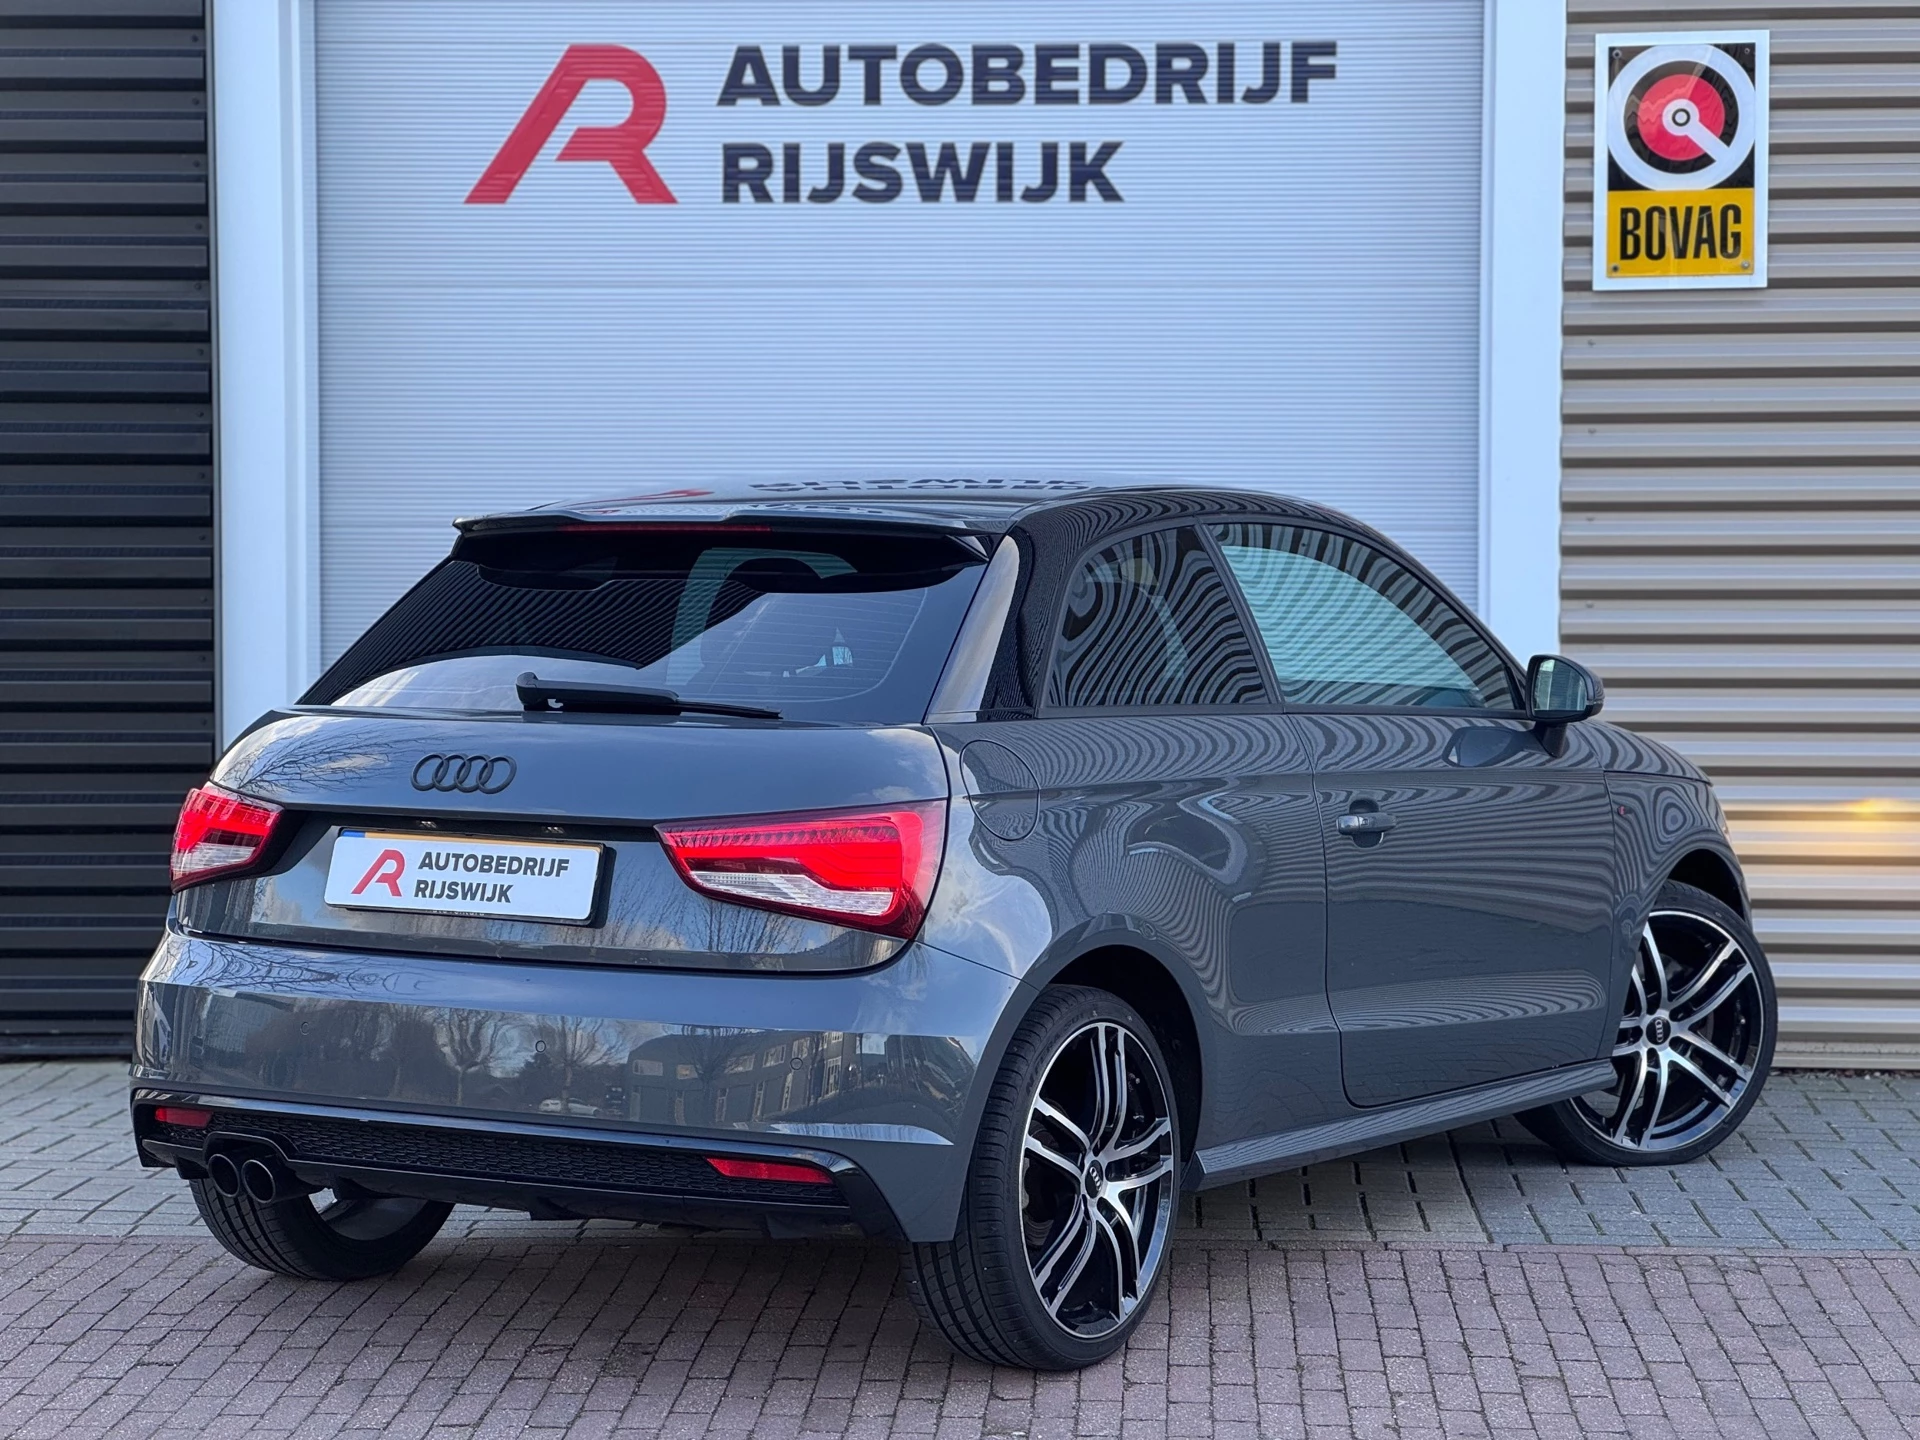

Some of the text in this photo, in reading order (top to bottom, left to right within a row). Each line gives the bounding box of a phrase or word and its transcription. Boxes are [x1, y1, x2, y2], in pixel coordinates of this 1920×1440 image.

[717, 42, 1337, 106] AUTOBEDRIJF
[722, 141, 1123, 204] RIJSWIJK
[1620, 204, 1742, 261] BOVAG
[414, 880, 513, 903] RIJSWIJK
[418, 851, 570, 877] AUTOBEDRIJF
